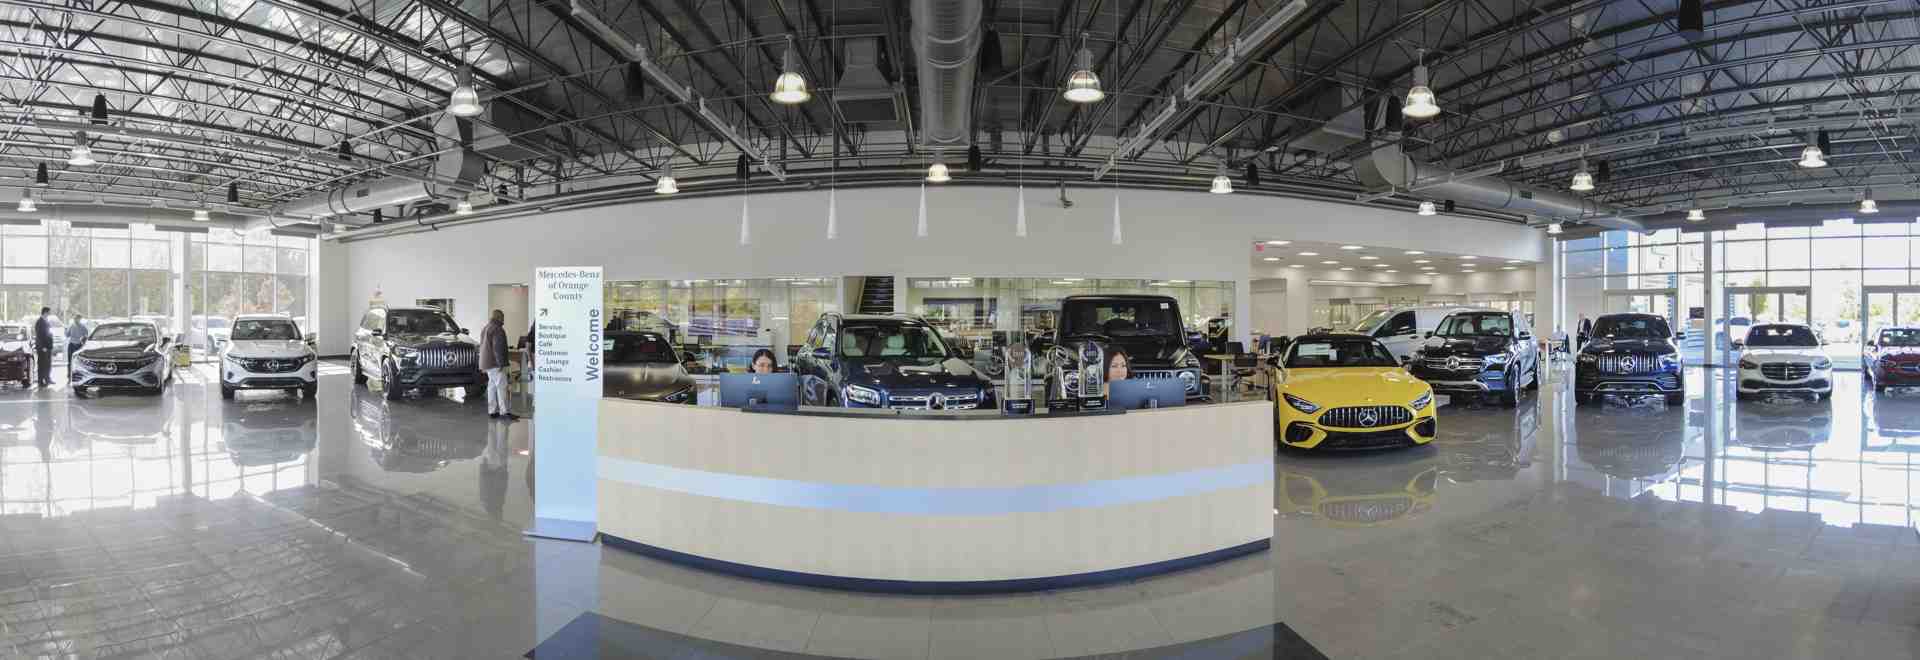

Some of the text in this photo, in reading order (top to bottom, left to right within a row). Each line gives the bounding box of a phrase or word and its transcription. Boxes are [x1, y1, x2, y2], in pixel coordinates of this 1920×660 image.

[558, 281, 590, 290] Orange
[552, 292, 583, 301] County
[538, 332, 567, 340] Boutique
[586, 308, 600, 382] Welcome
[546, 357, 570, 366] Lounge
